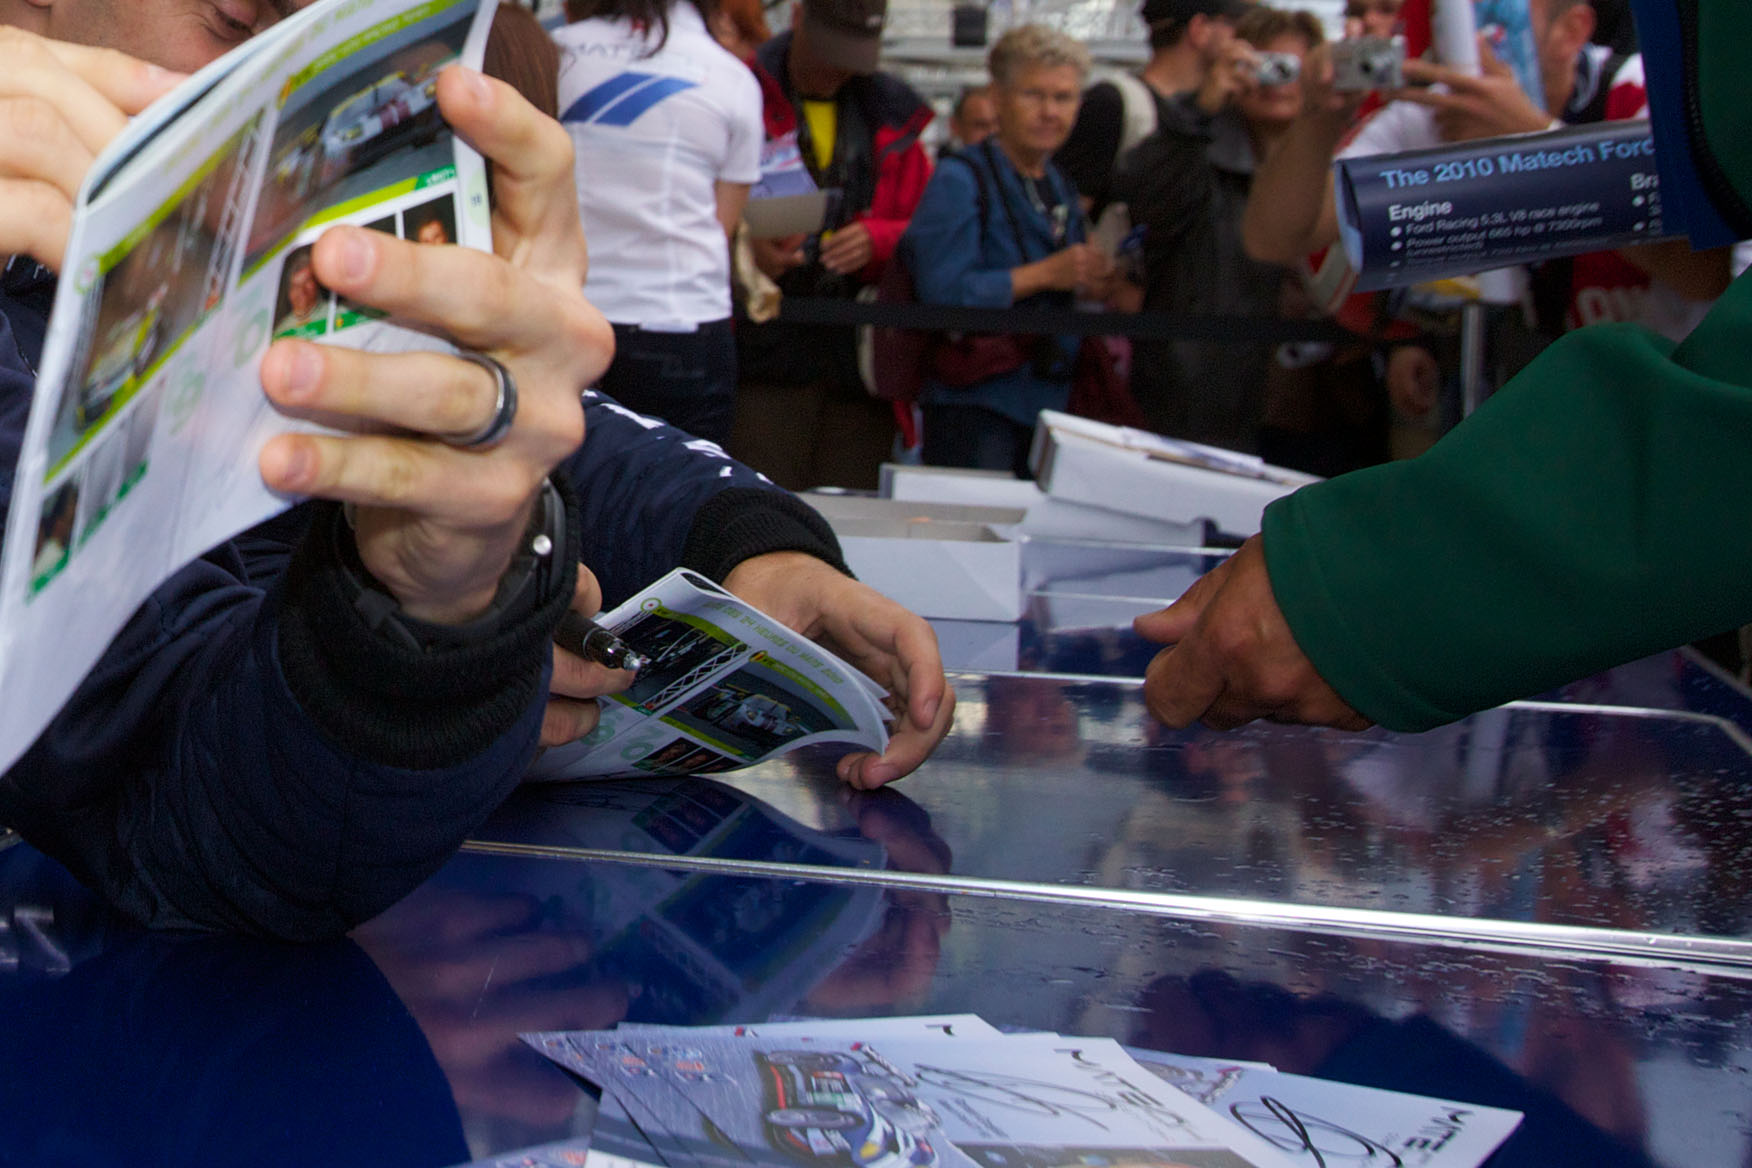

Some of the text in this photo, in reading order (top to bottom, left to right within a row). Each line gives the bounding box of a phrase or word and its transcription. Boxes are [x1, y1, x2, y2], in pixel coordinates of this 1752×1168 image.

[1380, 167, 1430, 189] The
[1432, 157, 1494, 183] 2010
[1497, 144, 1595, 174] Matech
[1388, 200, 1453, 224] Engine
